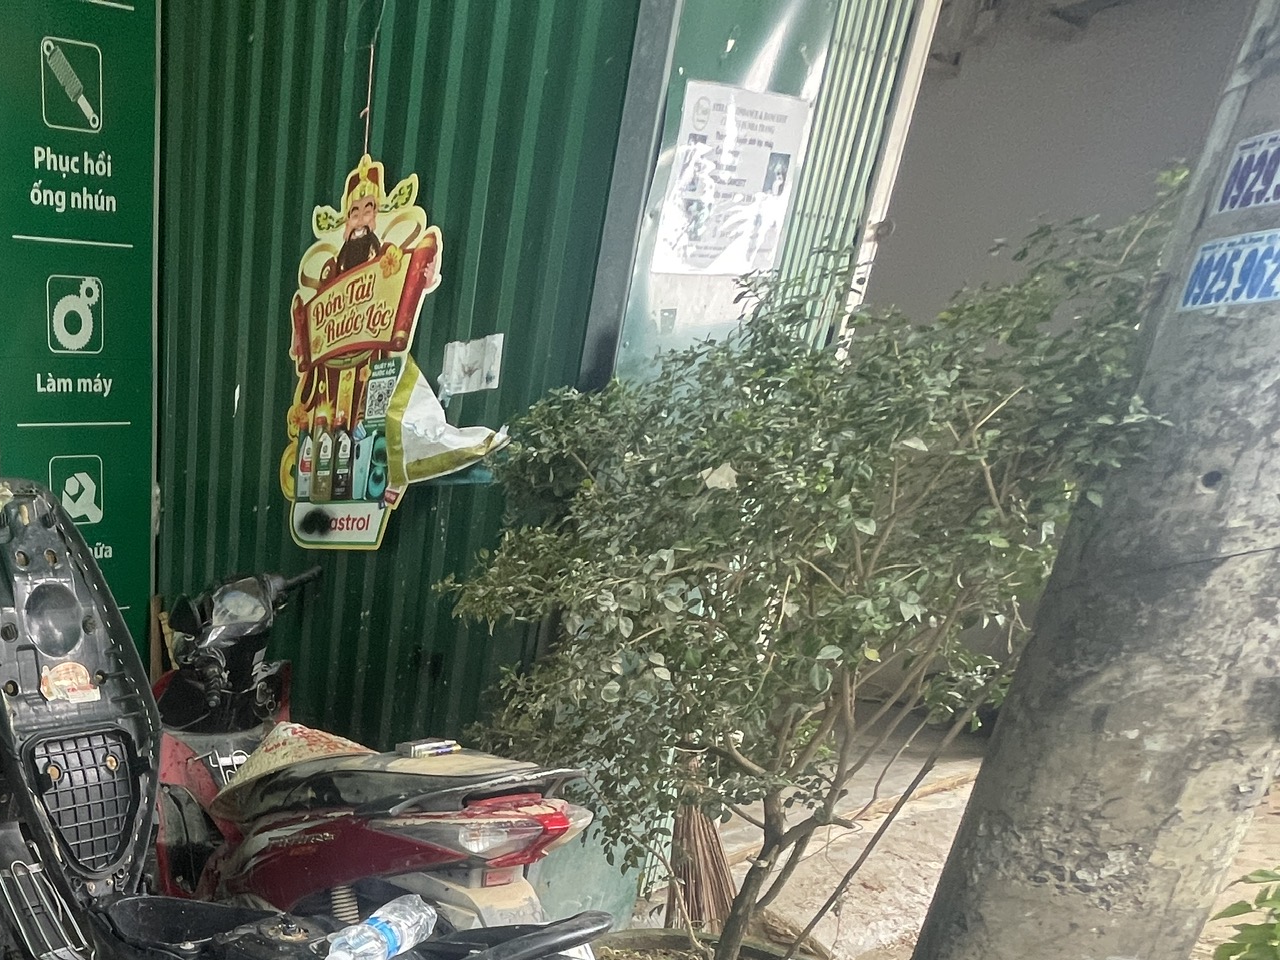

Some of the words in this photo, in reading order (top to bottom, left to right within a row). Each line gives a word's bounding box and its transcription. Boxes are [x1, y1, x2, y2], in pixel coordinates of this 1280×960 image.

[34, 146, 80, 179] Phục
[83, 151, 112, 177] hồi
[1219, 146, 1280, 213] 0929.
[30, 180, 66, 213] ống
[71, 187, 117, 212] nhún
[313, 292, 342, 326] Đón
[325, 307, 361, 343] Rước
[366, 301, 390, 334] Lộc
[36, 373, 73, 393] Làm
[77, 373, 113, 398] máy
[329, 514, 370, 531] astrol
